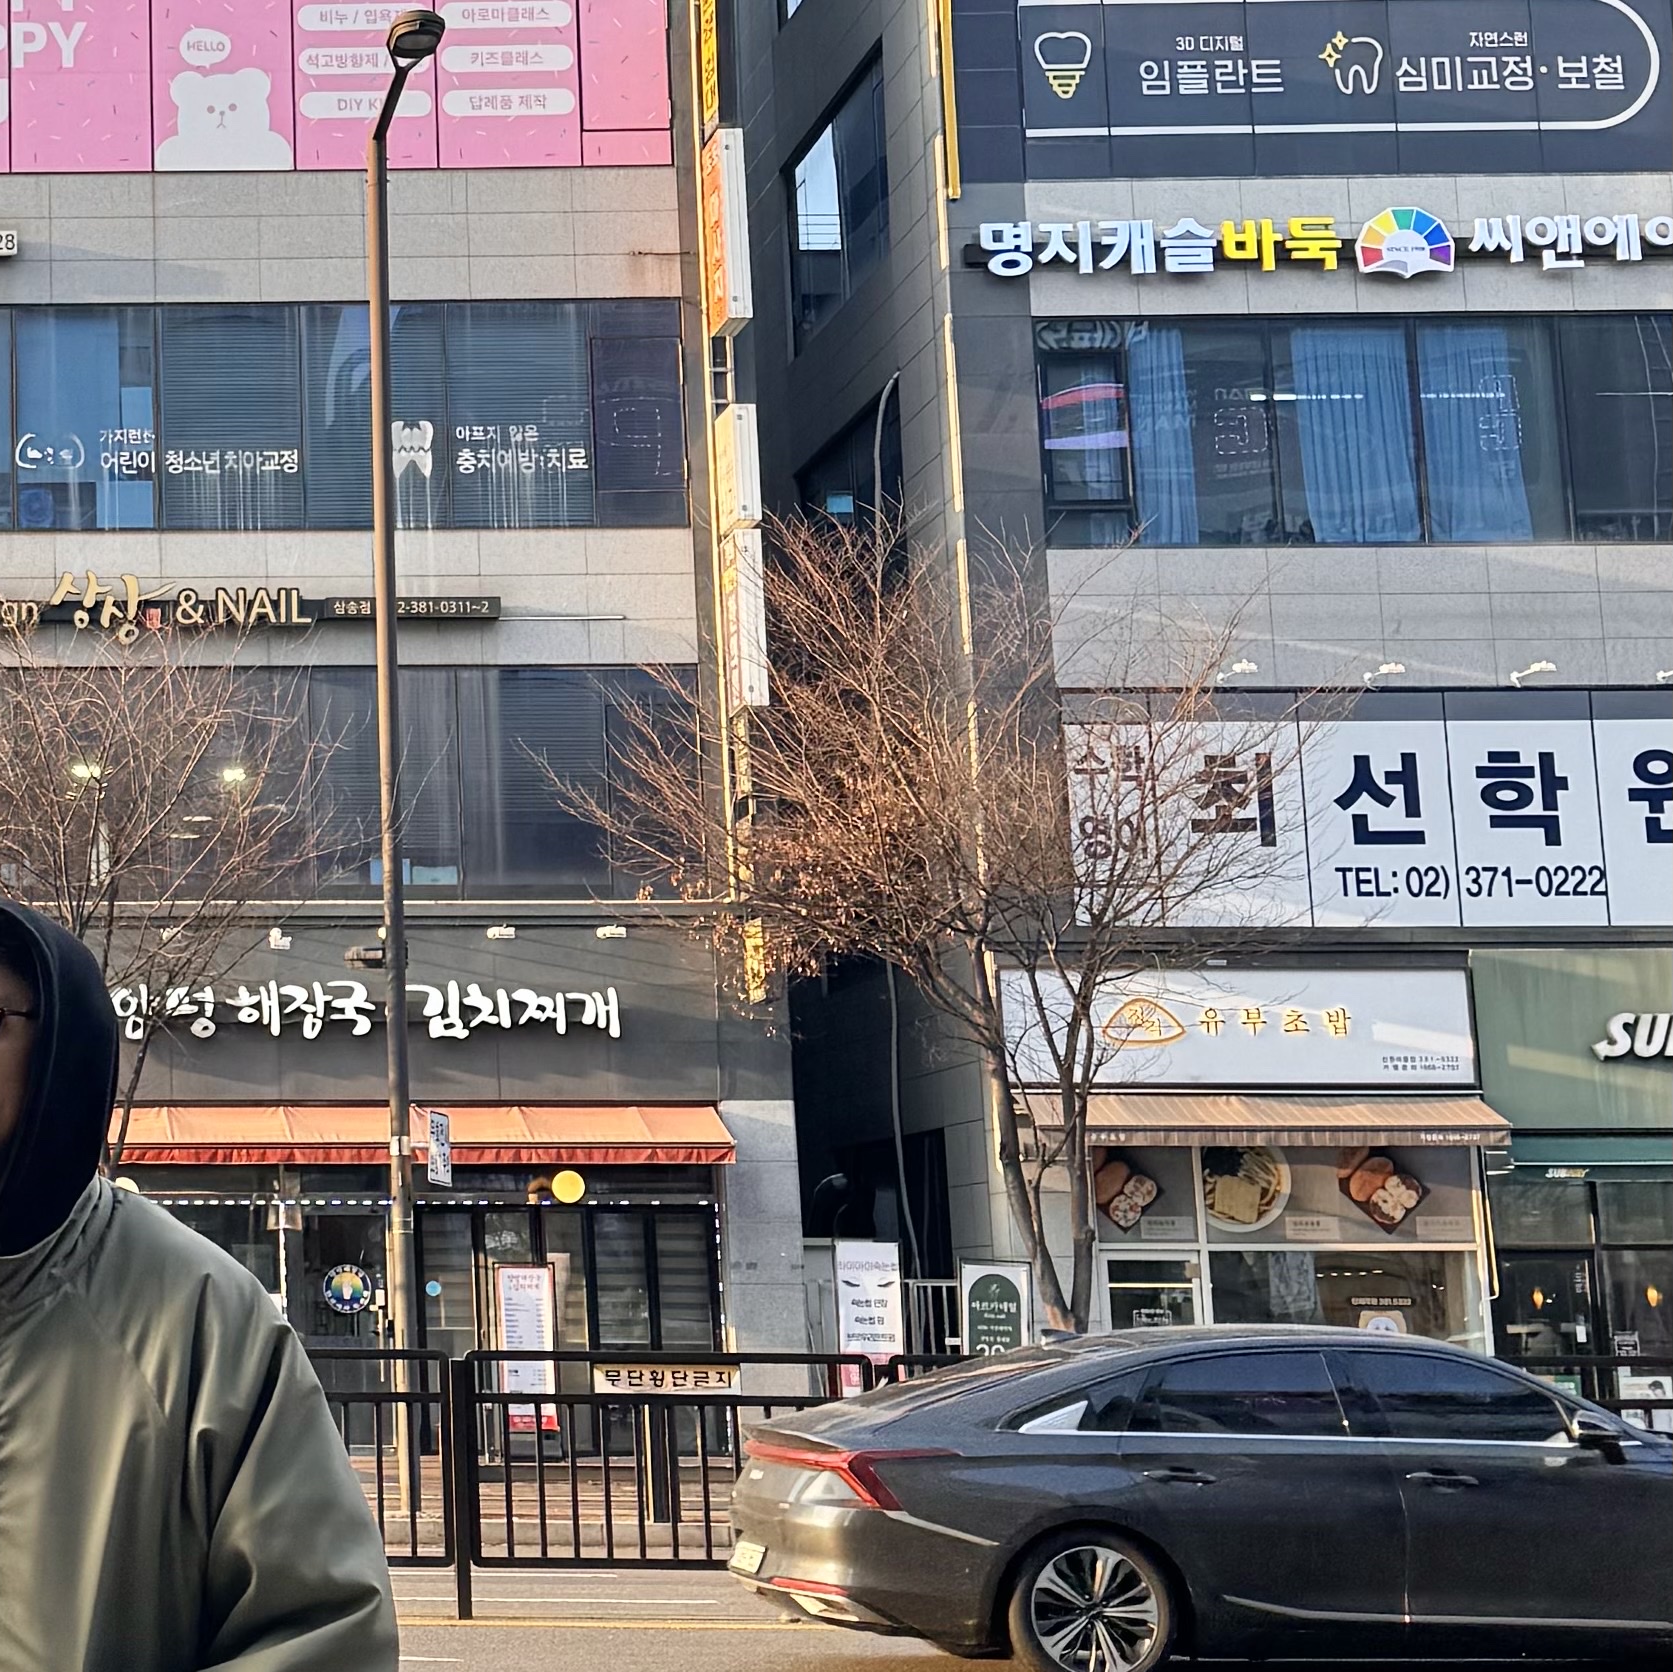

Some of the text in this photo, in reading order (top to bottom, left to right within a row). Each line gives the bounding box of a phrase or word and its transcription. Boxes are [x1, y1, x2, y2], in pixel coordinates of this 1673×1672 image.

[319, 9, 349, 25] 비누
[461, 7, 551, 22] 아로마클래스
[186, 40, 226, 53] HELLO
[1175, 34, 1244, 52] 3D 디지털
[1468, 31, 1528, 49] 자연스런
[306, 51, 379, 69] 석고방향제
[470, 50, 545, 66] 키즈클래스
[1139, 58, 1284, 96] 임플란트
[338, 97, 362, 112] DIY
[469, 94, 548, 111] 답례품 제작
[455, 424, 500, 442] 아프지
[100, 448, 298, 475] 어린이 청소년 치아교정
[175, 590, 203, 624] &
[216, 586, 312, 624] NAIL
[333, 599, 490, 616] 삼송점 2-381-0311~2
[1464, 864, 1607, 899] 371-0222
[225, 979, 377, 1040] 해장국
[405, 979, 622, 1041] 김치찌개
[1198, 1007, 1352, 1038] 유부초밥
[603, 1367, 734, 1389] 무단횡단금지
